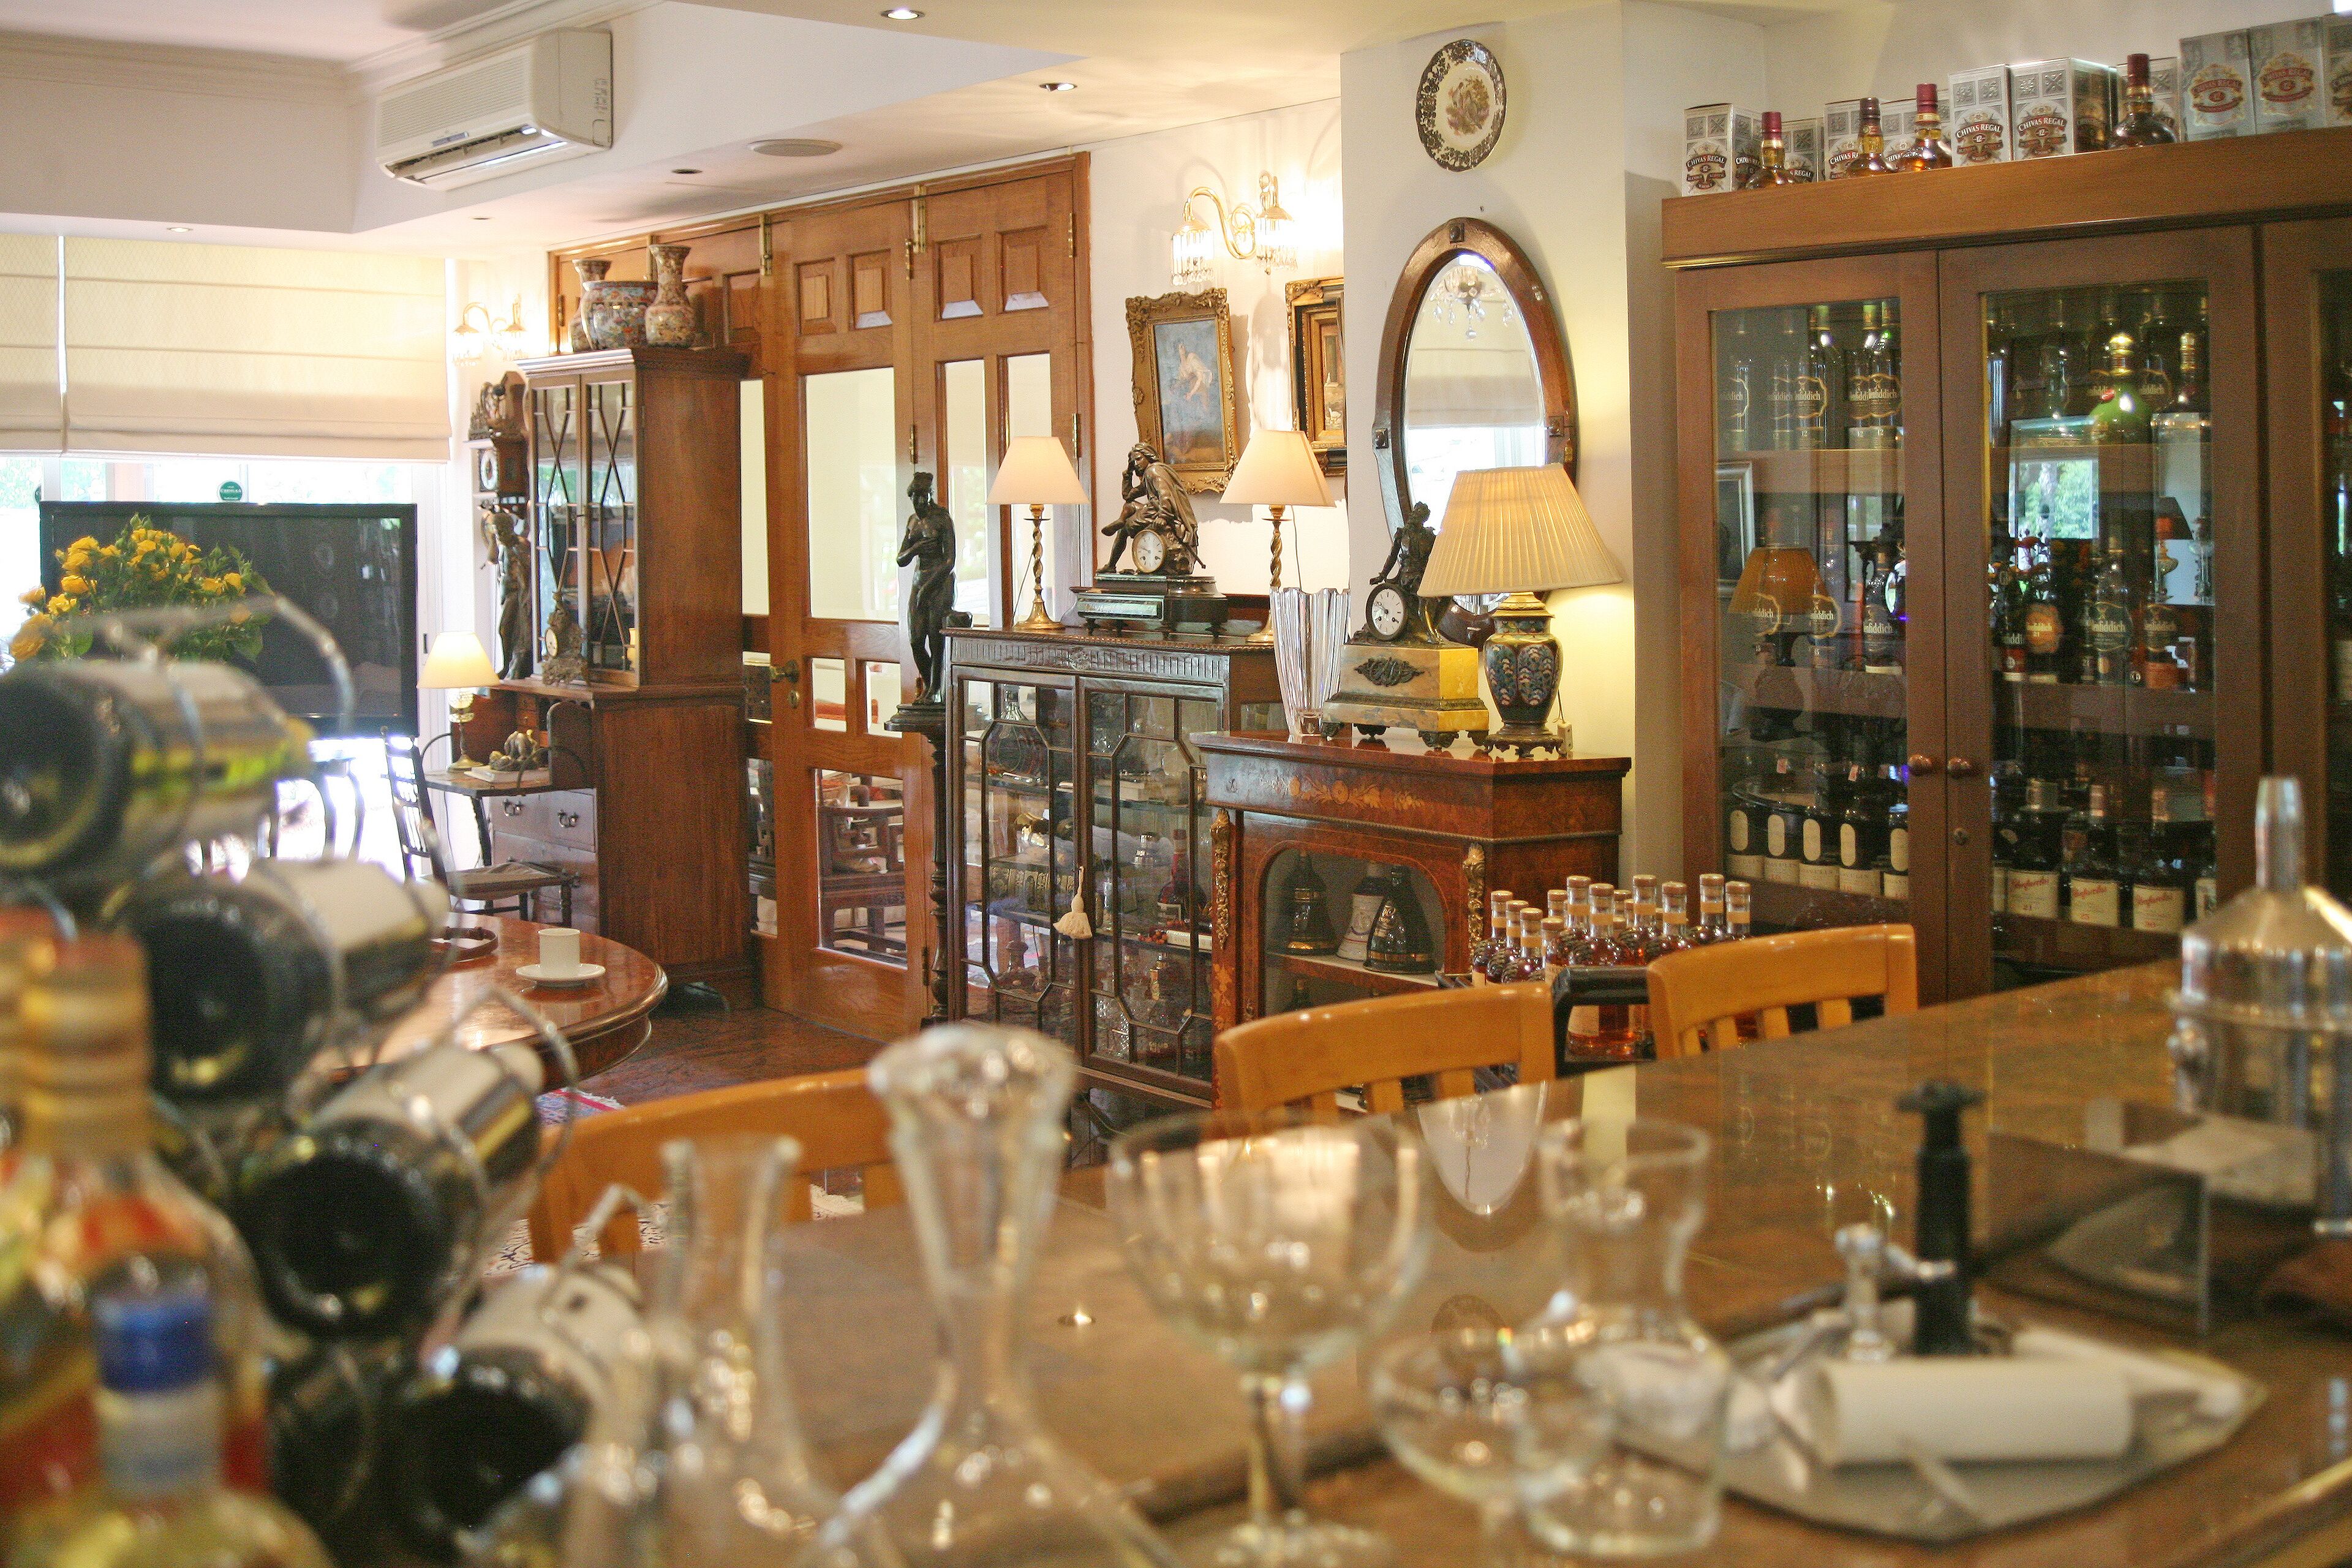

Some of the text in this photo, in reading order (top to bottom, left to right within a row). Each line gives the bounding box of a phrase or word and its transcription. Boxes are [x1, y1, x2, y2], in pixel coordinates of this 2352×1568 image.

[1956, 124, 2000, 138] CHIVAS REGAL
[2018, 118, 2065, 131] CHIVAS REGAL
[1687, 154, 1725, 168] CHIVAS REGAL
[1830, 153, 1852, 165] CHIVAS
